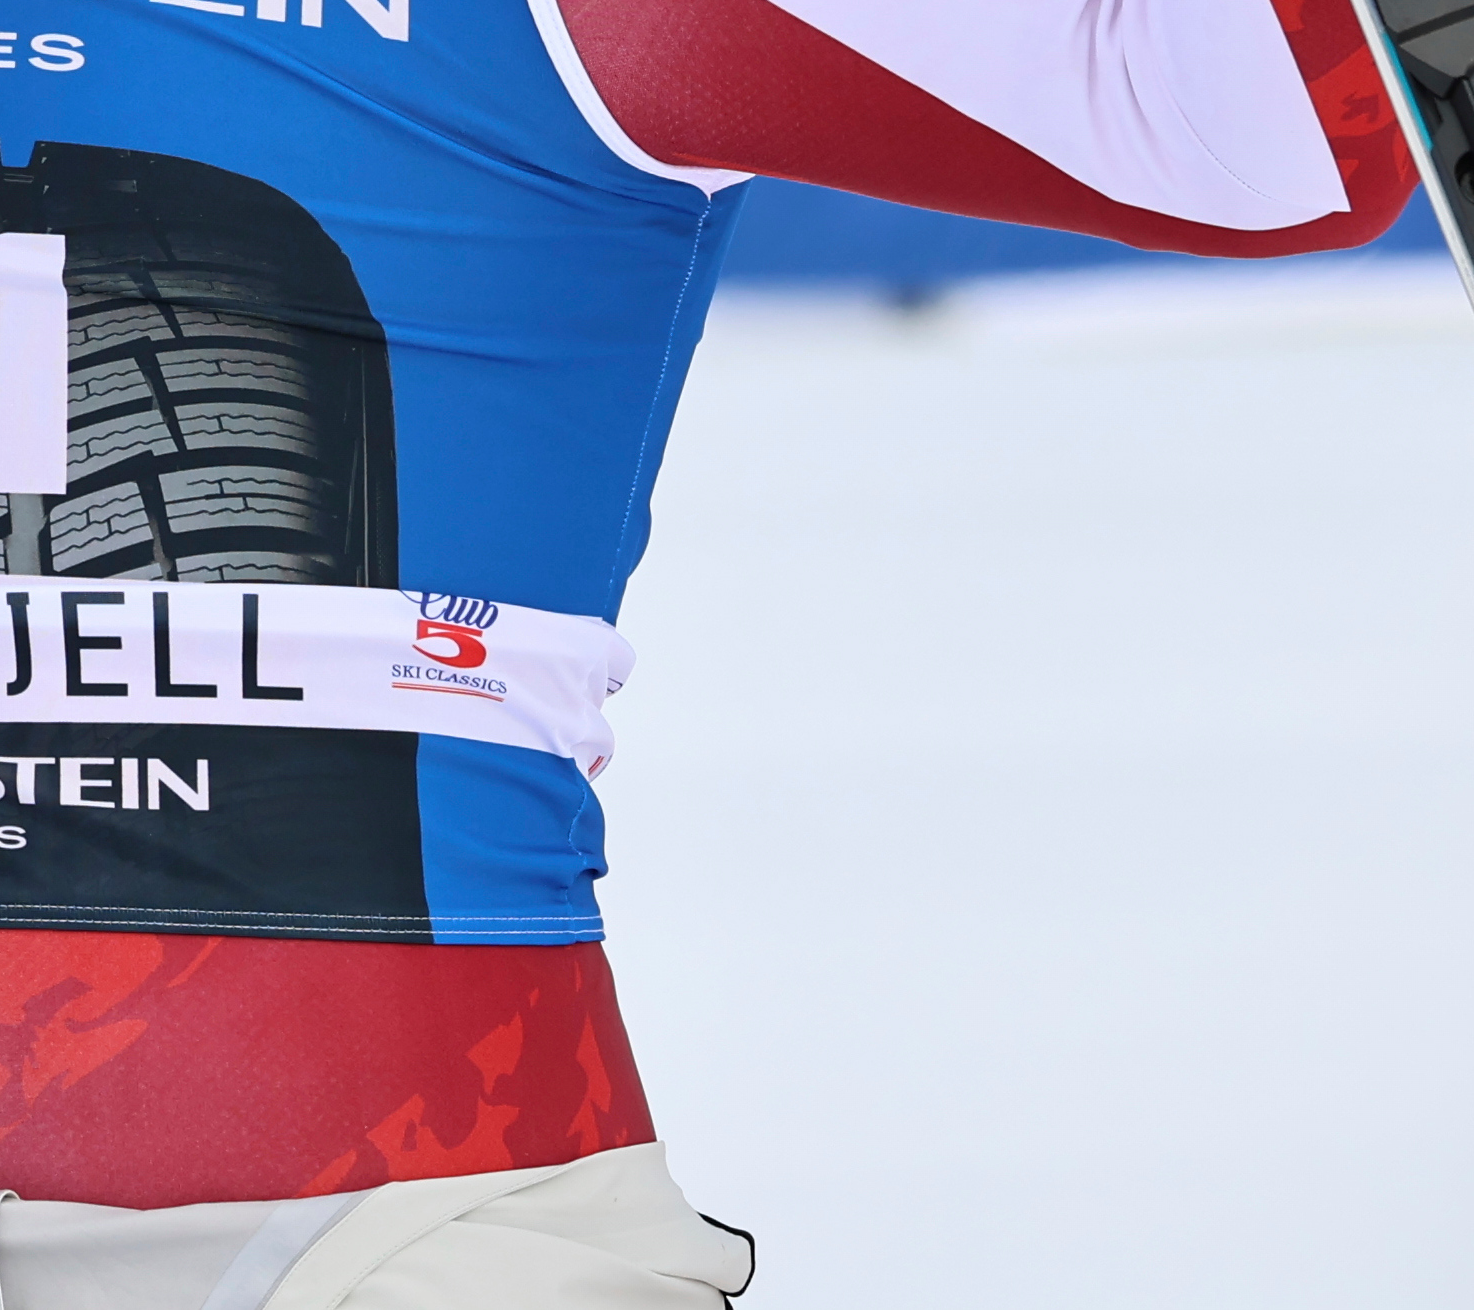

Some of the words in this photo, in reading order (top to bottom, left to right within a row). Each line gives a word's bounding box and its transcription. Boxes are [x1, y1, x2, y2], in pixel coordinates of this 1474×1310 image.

[412, 619, 487, 669] 5
[391, 664, 421, 679] SKI
[425, 667, 508, 695] CLASSICS
